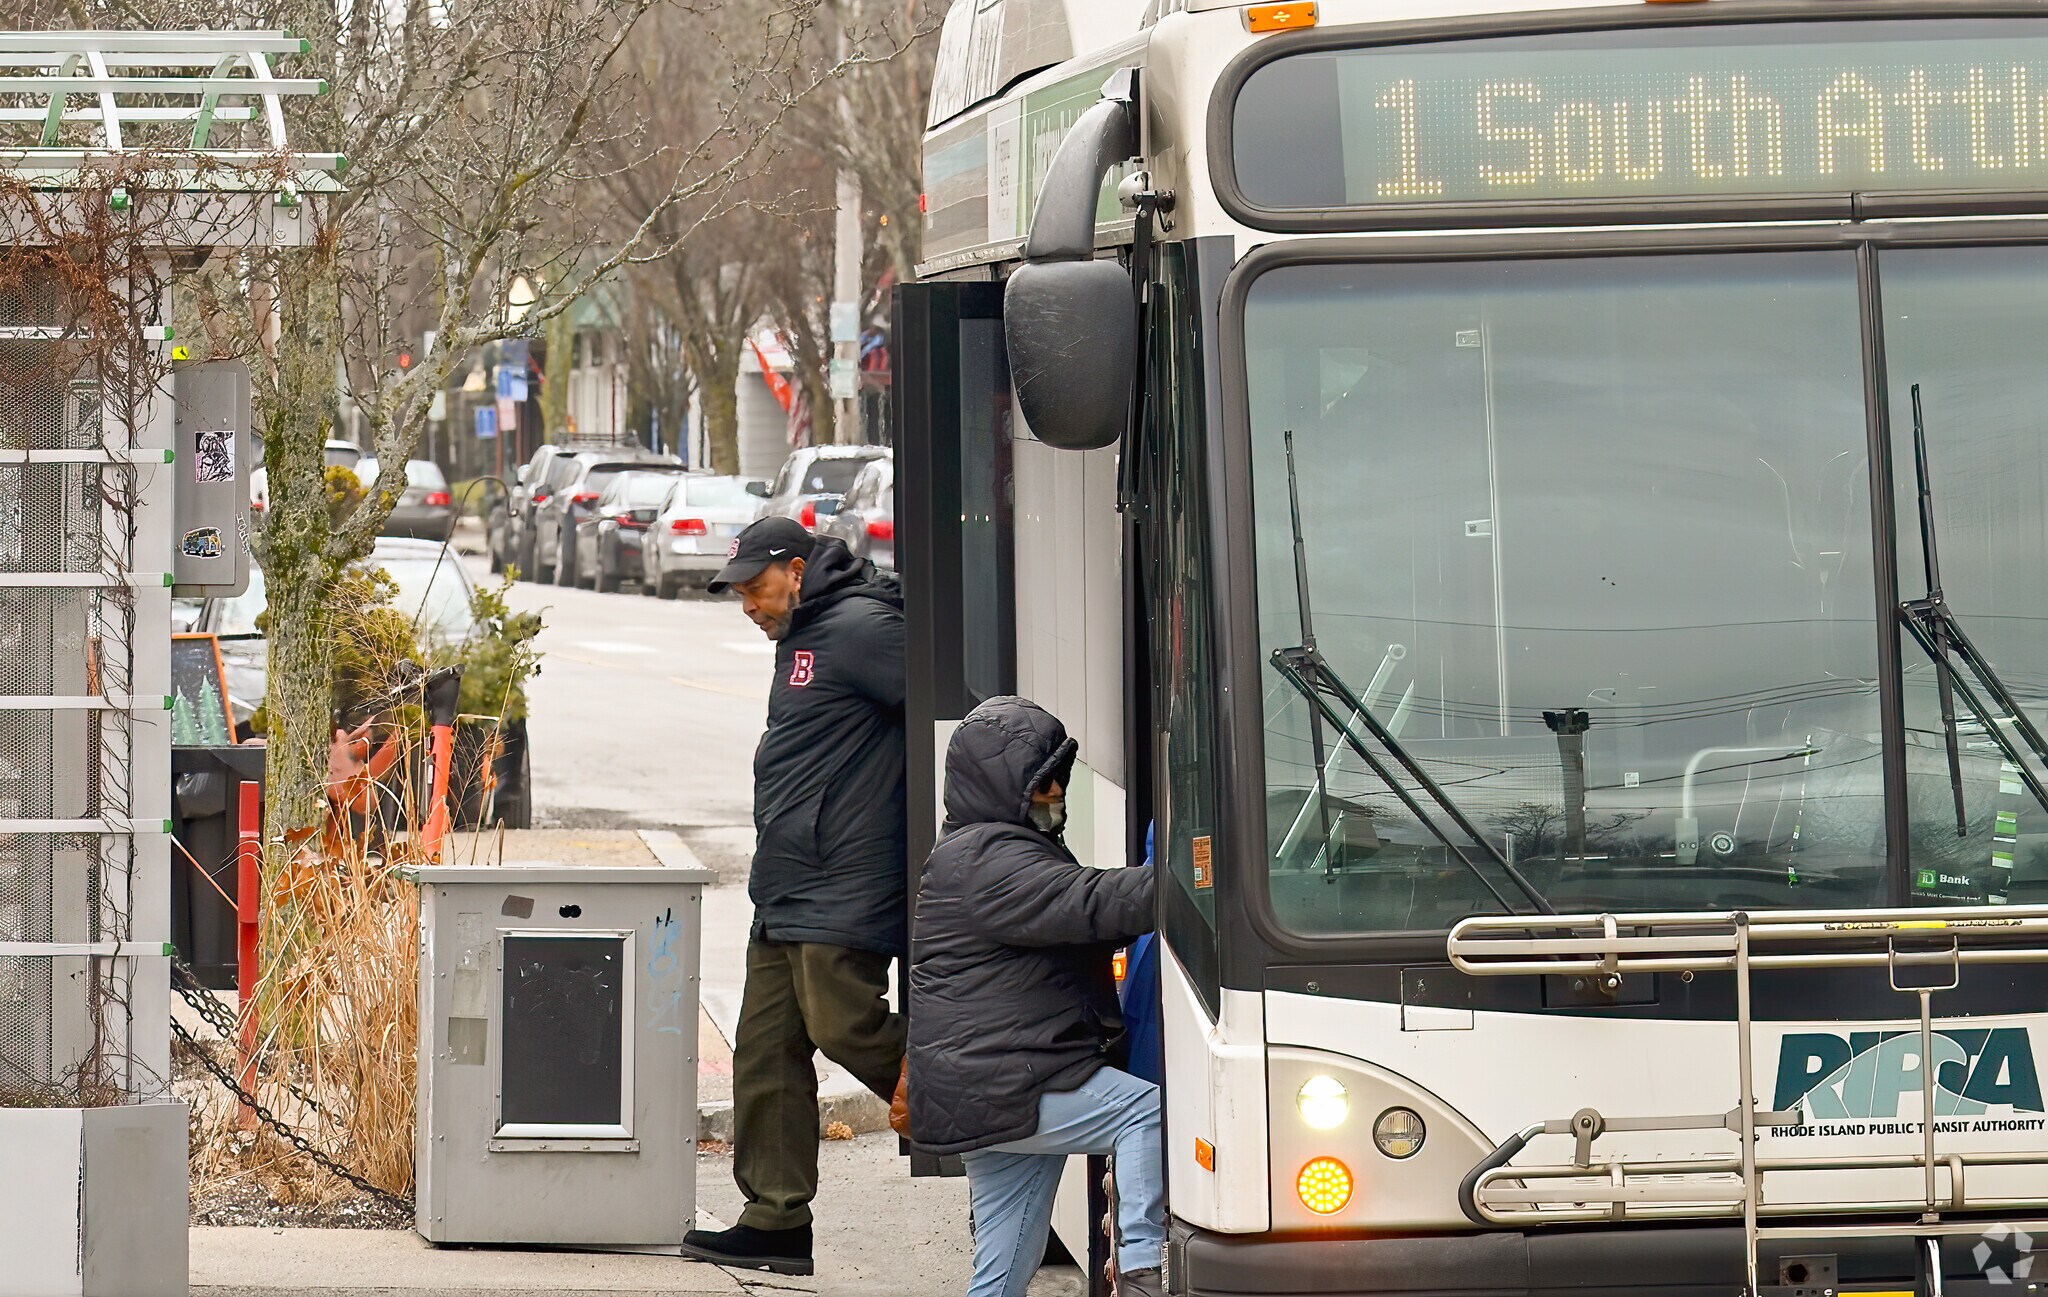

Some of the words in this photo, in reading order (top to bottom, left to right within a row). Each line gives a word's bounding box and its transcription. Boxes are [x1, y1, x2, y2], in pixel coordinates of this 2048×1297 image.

[1374, 78, 1443, 195] 1
[1476, 75, 1784, 185] South
[1816, 66, 2048, 174] Attl
[789, 650, 815, 688] B
[1939, 874, 1970, 886] Bank
[1773, 1027, 2045, 1119] RIPTA
[1771, 1125, 1815, 1138] RHODE
[1818, 1123, 1866, 1137] ISLAND
[1869, 1122, 1915, 1135] PUBLIC
[1916, 1121, 1970, 1134] TANSIT
[1972, 1119, 2046, 1133] AUTHORITY
